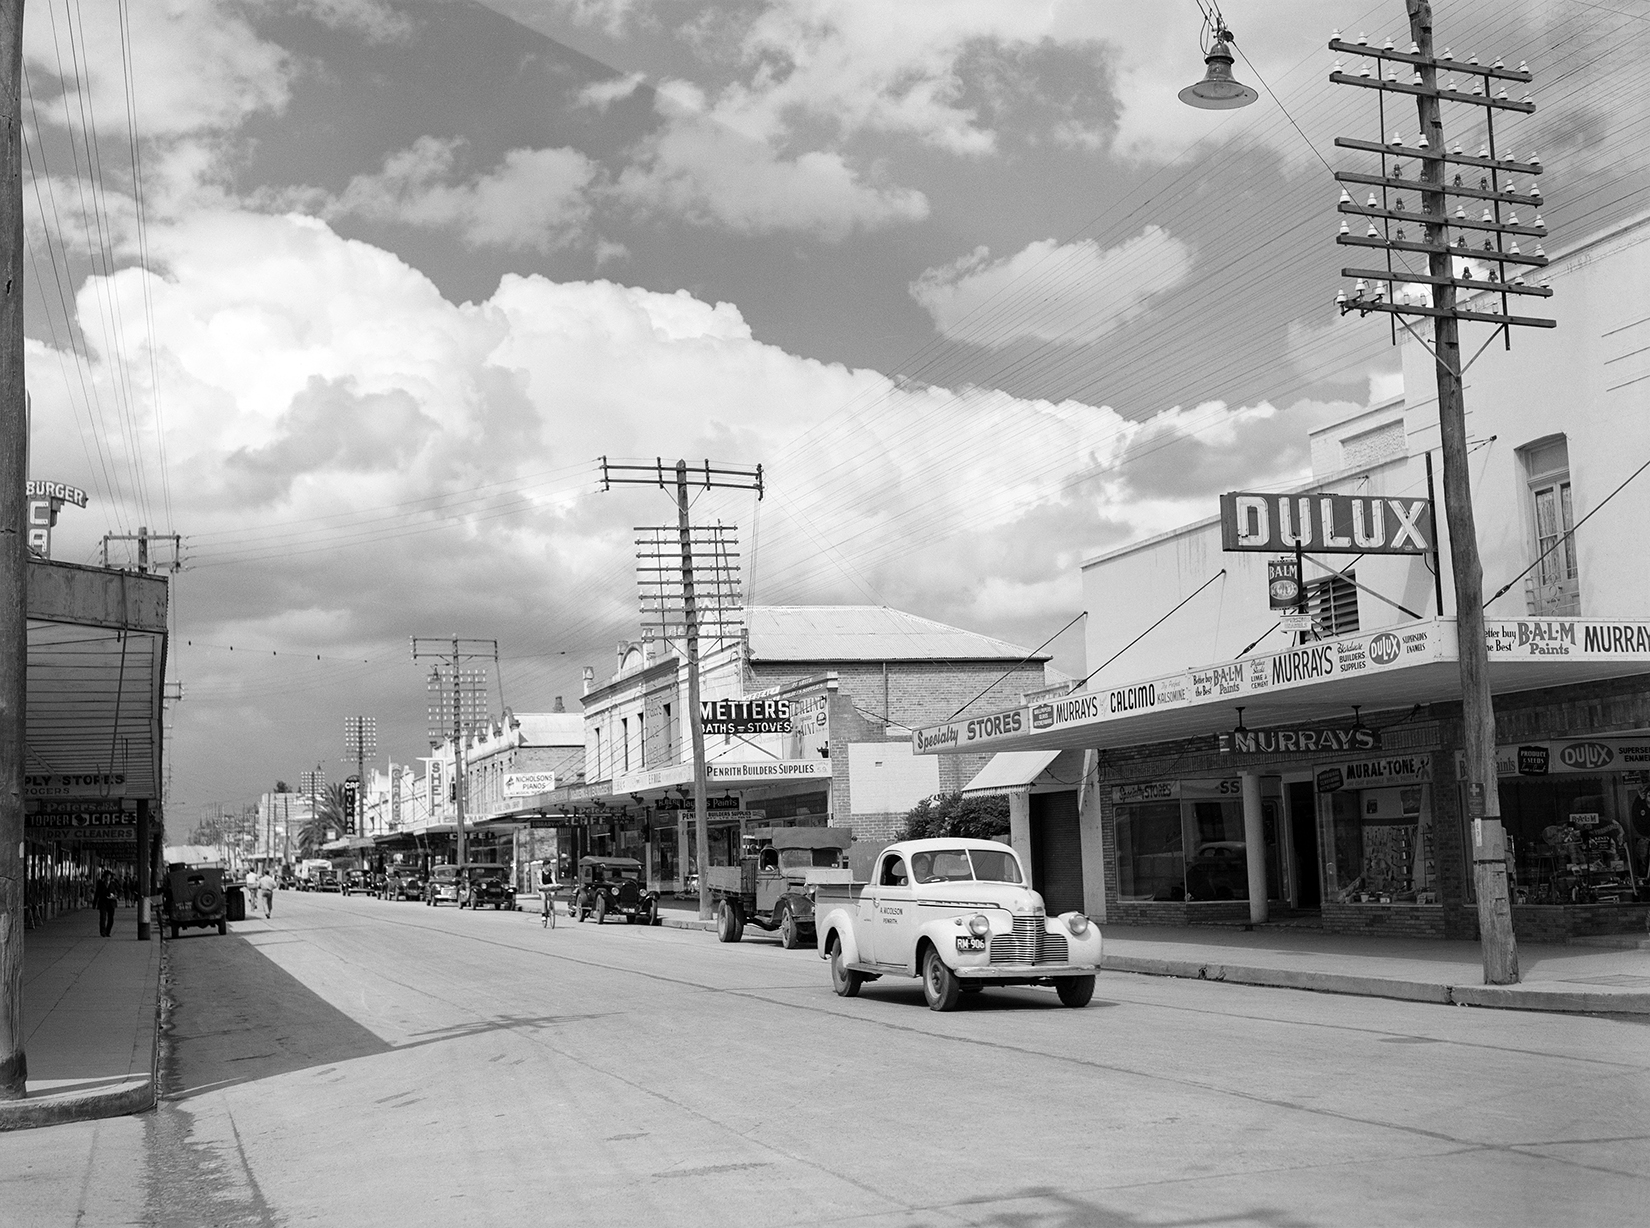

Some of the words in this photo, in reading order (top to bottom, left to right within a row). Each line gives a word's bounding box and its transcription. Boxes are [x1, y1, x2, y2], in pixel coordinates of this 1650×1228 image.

[26, 481, 84, 506] BURGER
[1235, 496, 1429, 550] DULUX
[1485, 626, 1500, 638] etter
[1502, 625, 1517, 643] buy
[1370, 635, 1399, 661] DULUX
[1496, 639, 1512, 652] Best
[1528, 643, 1570, 655] Paints
[1340, 651, 1366, 663] BUILDERS
[1272, 645, 1333, 686] MURRAYS
[1340, 660, 1367, 673] SUPPLIES
[1219, 682, 1240, 695] Paints
[700, 700, 790, 720] METTERS
[1056, 696, 1098, 724] MURRAYS
[701, 722, 735, 734] BATHS
[747, 722, 791, 733] STOVES
[917, 724, 959, 753] Specialty
[967, 711, 1022, 741] STORES
[1234, 729, 1374, 753] MURRAYS
[1520, 750, 1546, 758] PRODUCE
[1564, 743, 1611, 769] DULUX
[1618, 747, 1650, 755] SUPERSE
[1497, 757, 1516, 772] aints
[1527, 757, 1545, 765] SEEDS
[706, 765, 742, 777] PENRITH
[742, 764, 778, 776] BUILDERS
[62, 774, 125, 785] STORES
[516, 774, 553, 783] NICHOLSONS
[522, 782, 546, 790] PIANOS
[1144, 783, 1172, 799] STORES
[392, 770, 400, 820] GARAGE
[43, 802, 97, 812] Peters
[713, 797, 738, 808] Paints
[92, 813, 129, 825] CAFE
[571, 817, 606, 825] CAFE
[47, 830, 70, 839] DRY
[74, 829, 133, 838] CLEANERS
